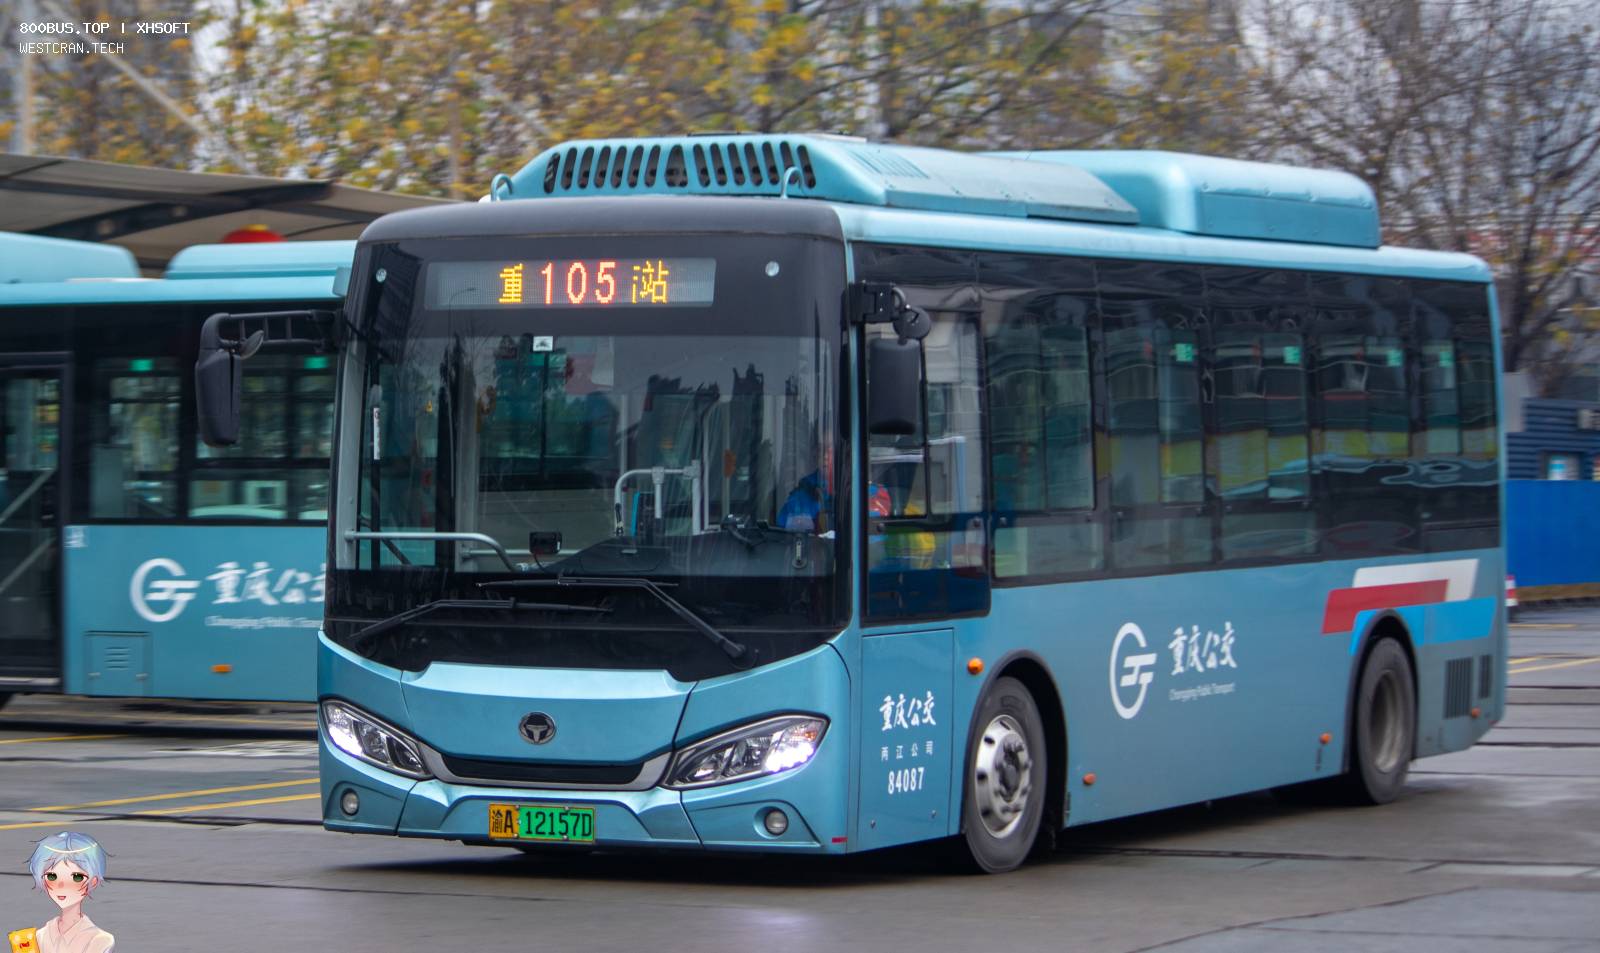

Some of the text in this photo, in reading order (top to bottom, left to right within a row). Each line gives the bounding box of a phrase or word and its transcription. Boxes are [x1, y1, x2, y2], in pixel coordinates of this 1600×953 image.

[541, 260, 616, 304] 105
[1168, 621, 1238, 676] 重庆公交
[879, 690, 937, 731] 重庆公交
[887, 766, 925, 795] 84087
